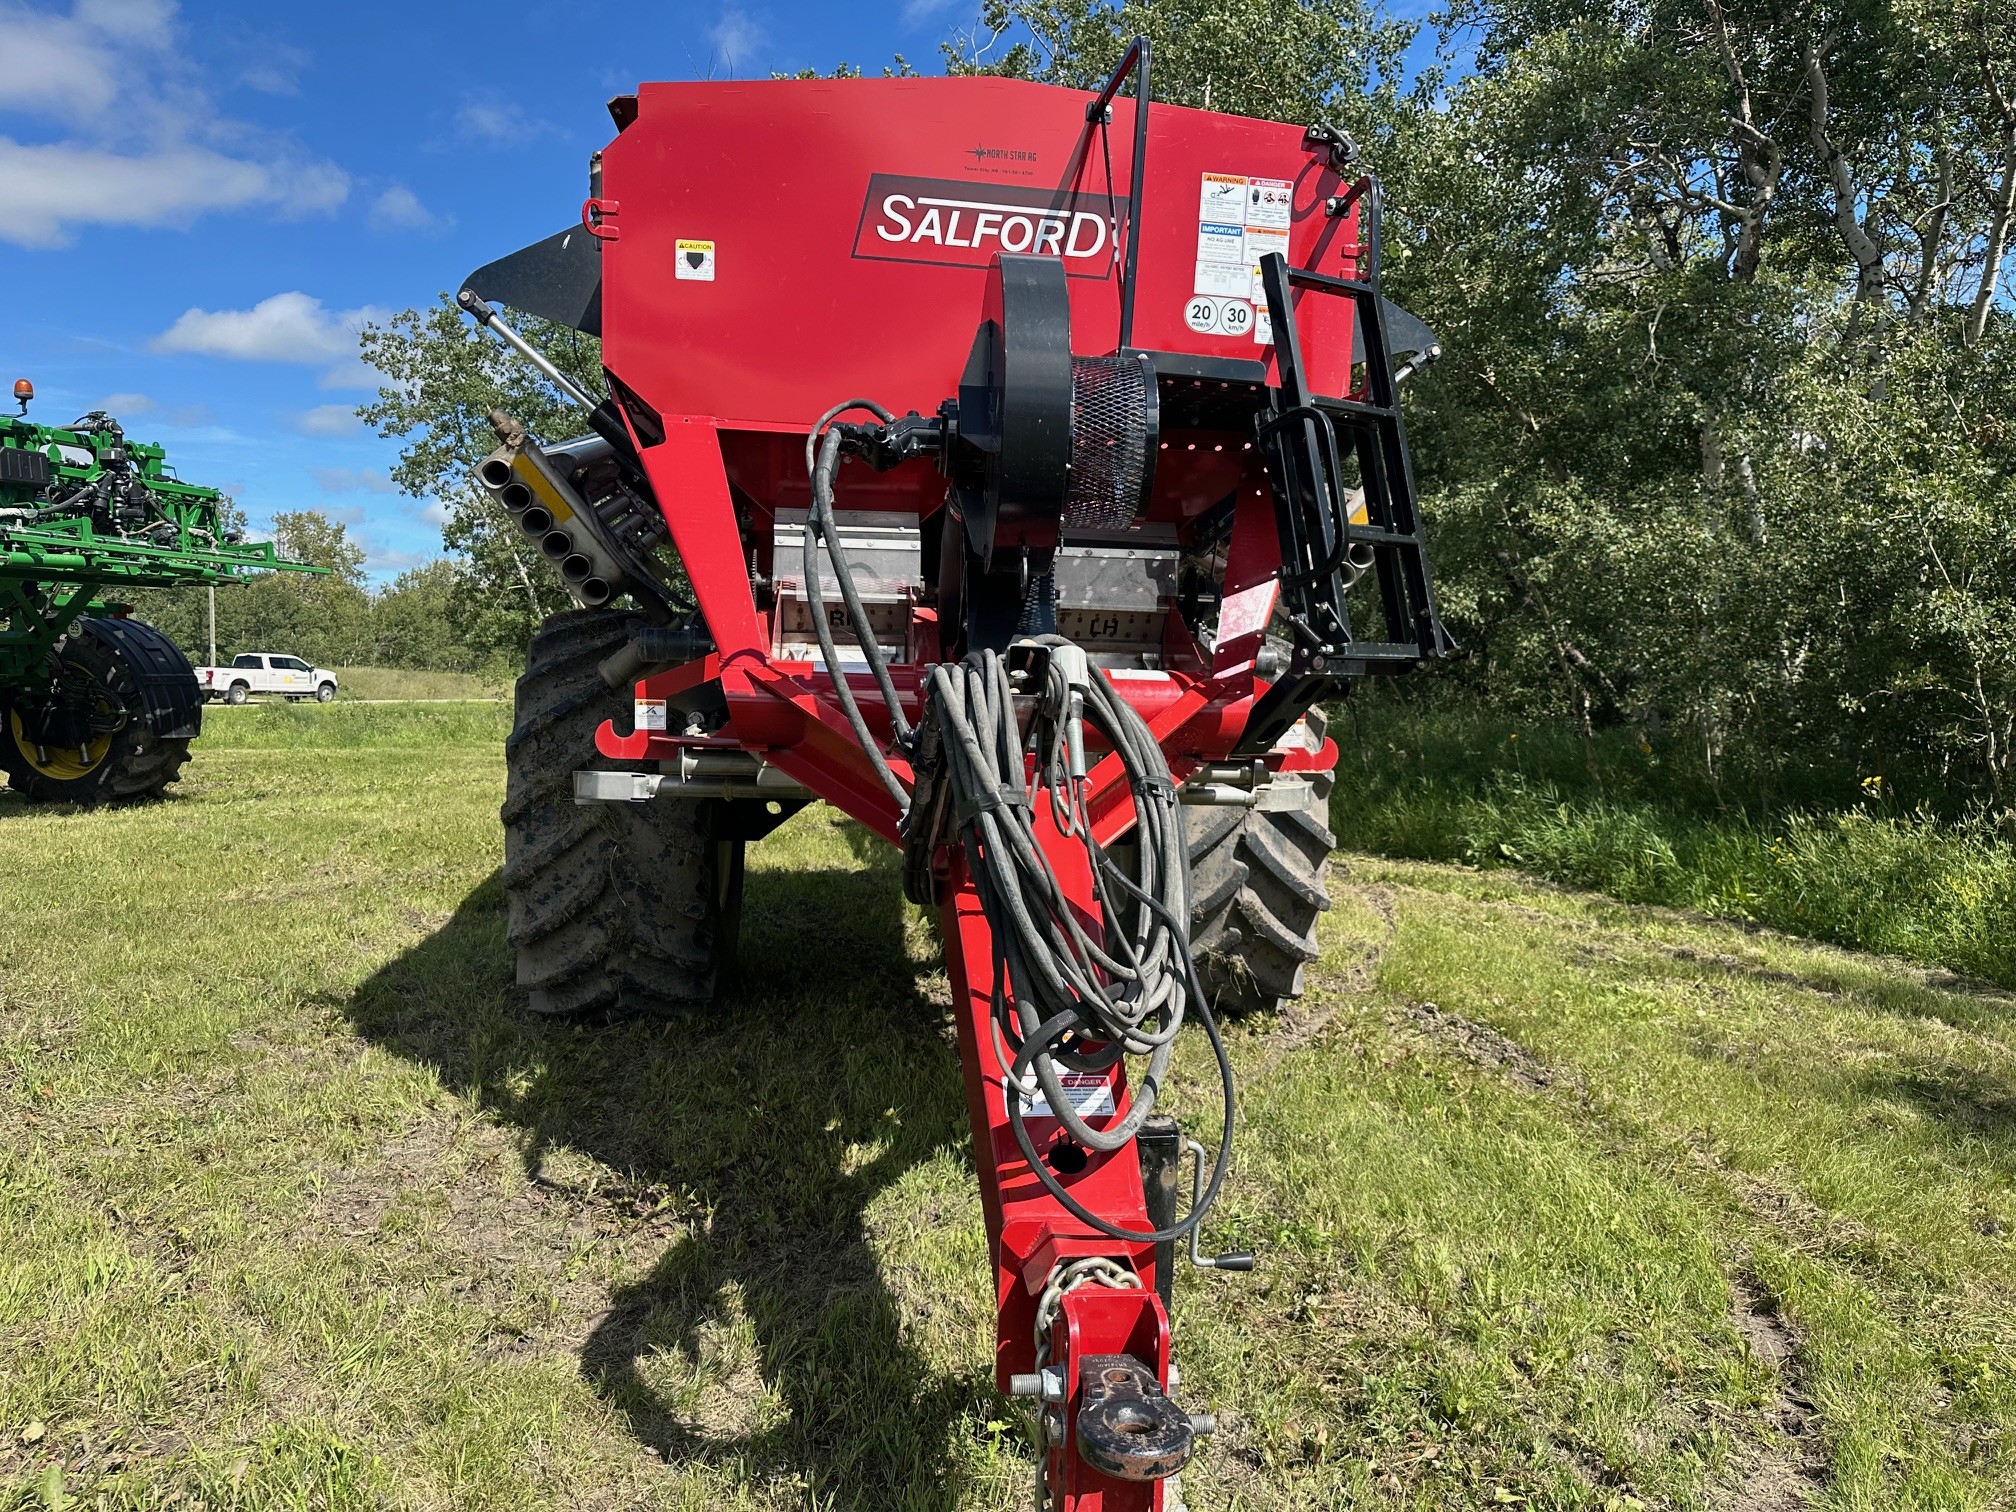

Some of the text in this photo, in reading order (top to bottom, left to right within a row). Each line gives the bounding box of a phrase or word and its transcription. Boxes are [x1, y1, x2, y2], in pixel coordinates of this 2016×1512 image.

[986, 148, 1037, 162] NORTH STAR AG
[1212, 174, 1244, 185] WARNING
[1260, 180, 1286, 188] DANGER
[876, 193, 1107, 259] SALFORD
[1202, 225, 1242, 236] IMPORTANT
[1192, 304, 1211, 320] 20
[1227, 307, 1247, 324] 30
[1191, 320, 1211, 329] mile/h
[1228, 324, 1244, 332] km/h
[71, 621, 79, 631] 55
[1089, 619, 1119, 635] LH
